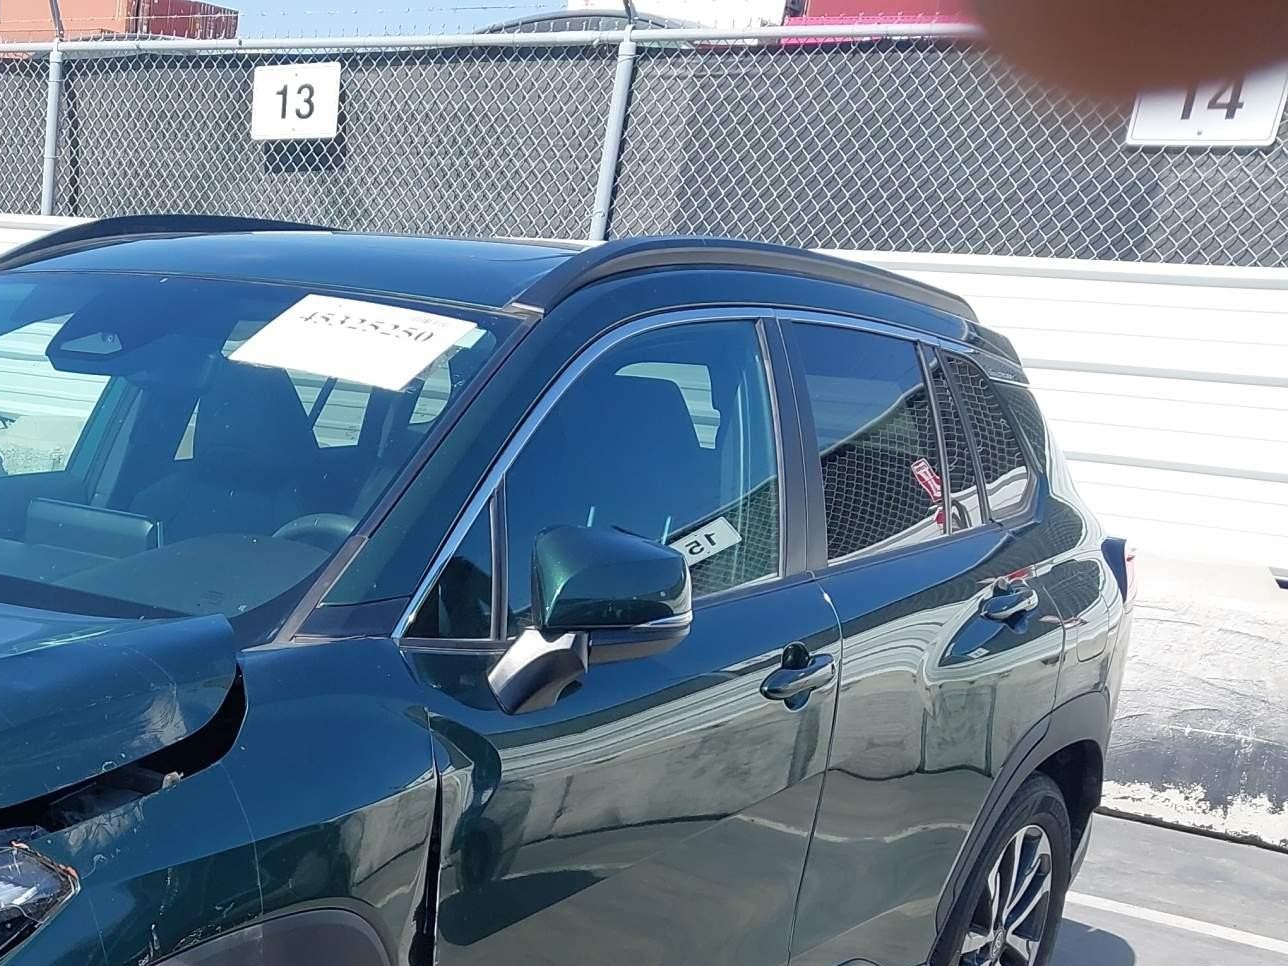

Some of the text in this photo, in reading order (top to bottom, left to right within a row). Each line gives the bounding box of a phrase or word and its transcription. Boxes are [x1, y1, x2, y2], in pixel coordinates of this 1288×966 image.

[275, 83, 315, 119] 13
[1180, 76, 1245, 120] 14
[299, 311, 434, 342] 45325250
